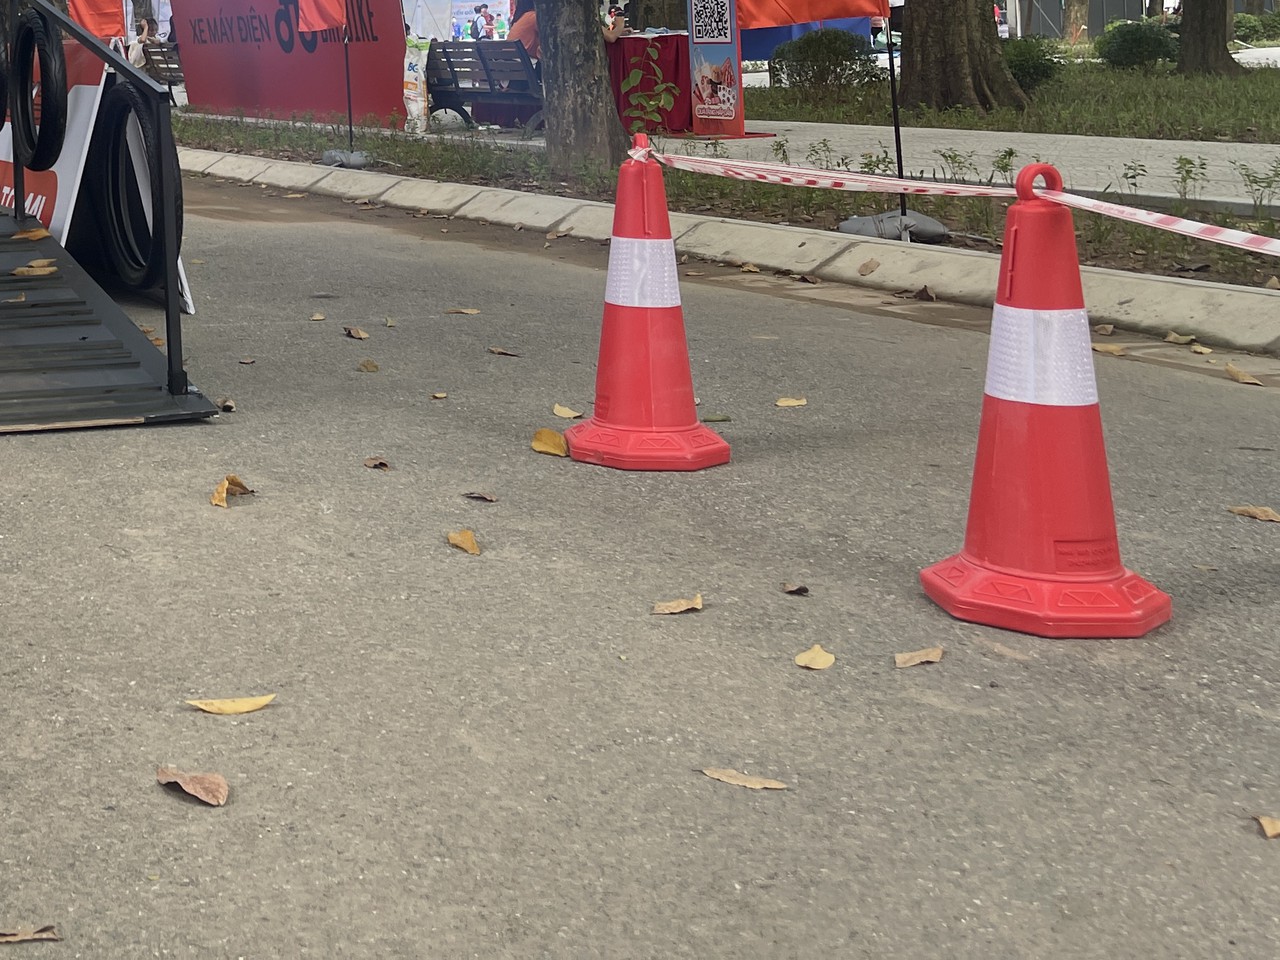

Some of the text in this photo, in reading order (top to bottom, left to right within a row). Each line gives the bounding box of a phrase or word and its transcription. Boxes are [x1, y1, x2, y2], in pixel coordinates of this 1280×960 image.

[189, 5, 271, 50] XE MÁY ĐIỆN
